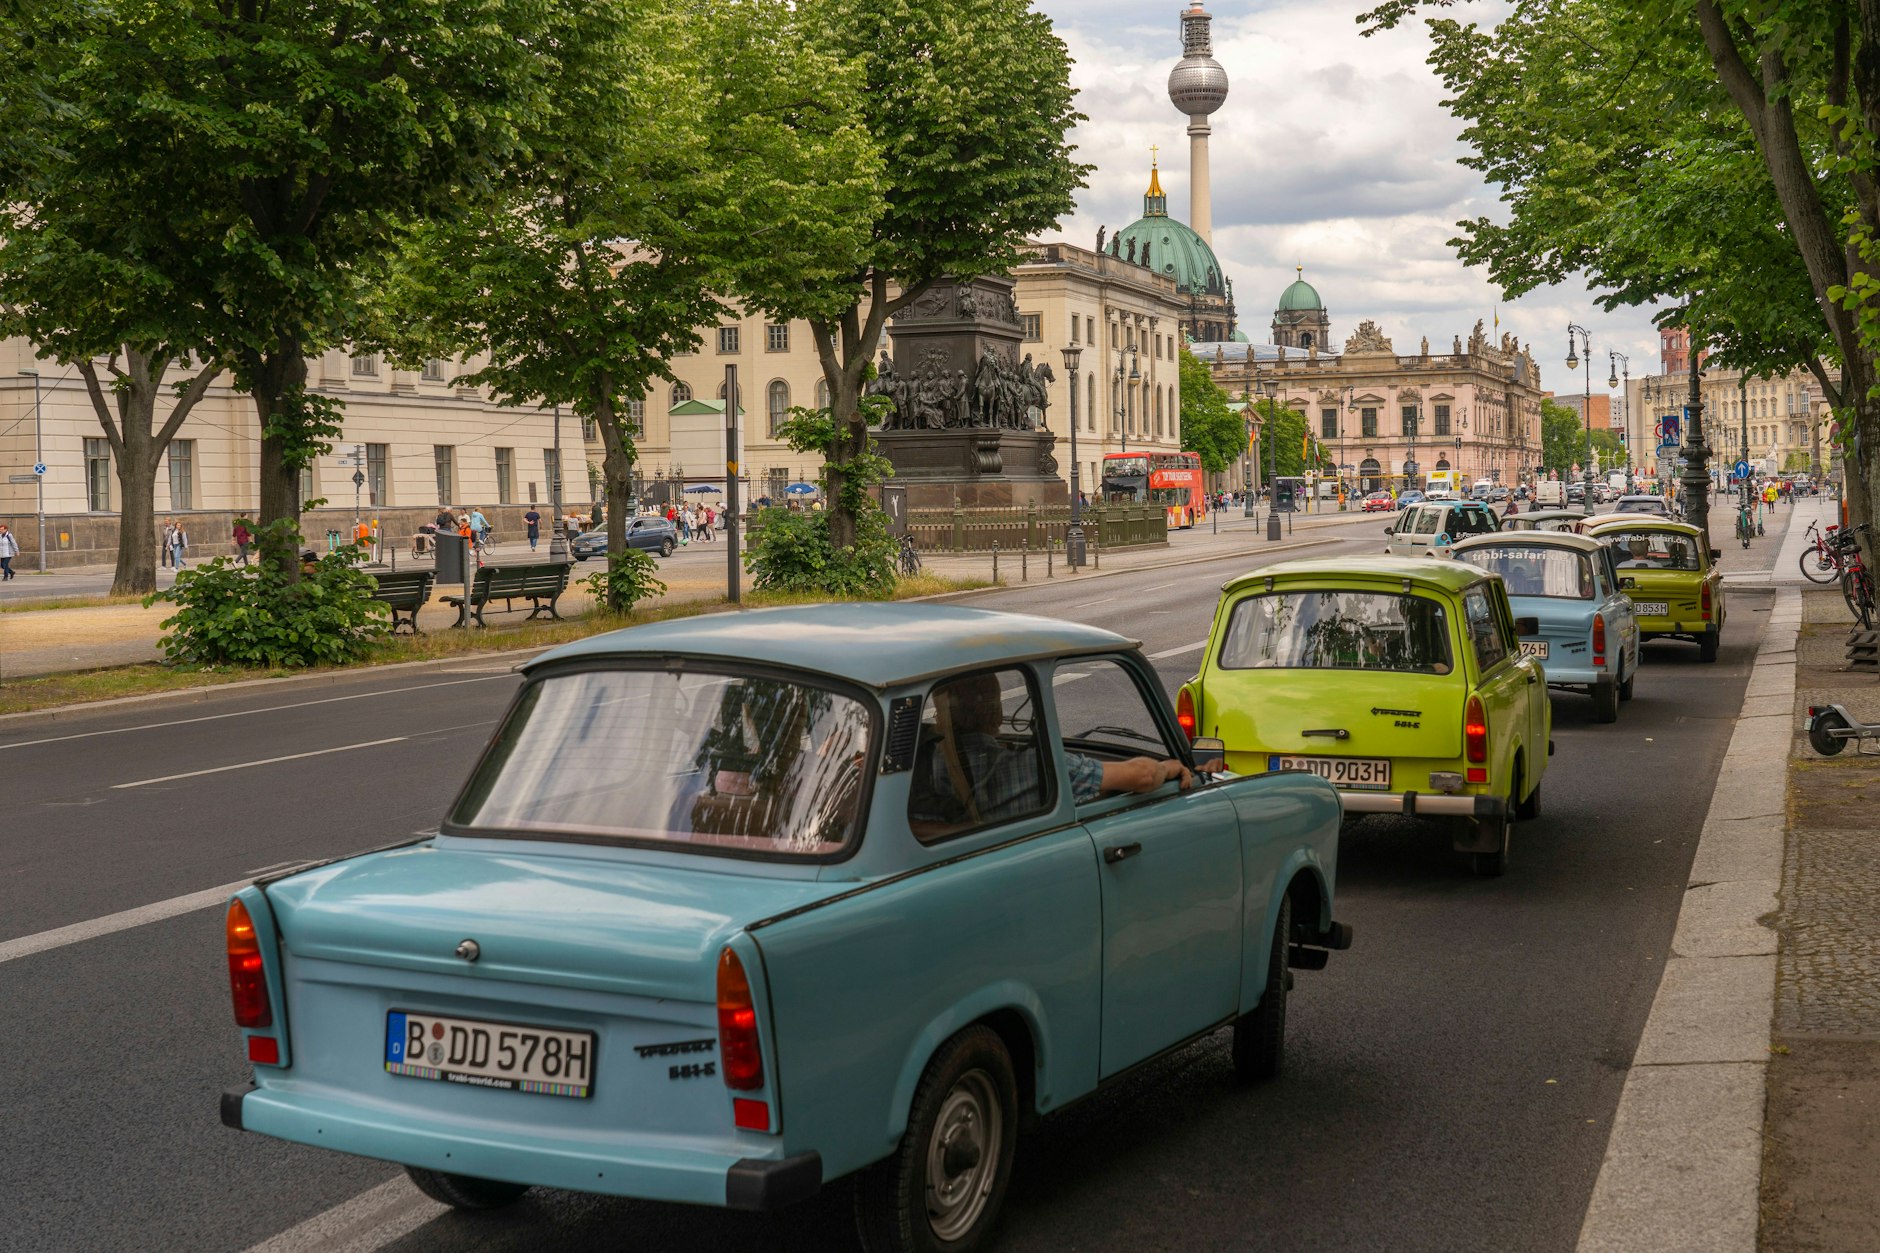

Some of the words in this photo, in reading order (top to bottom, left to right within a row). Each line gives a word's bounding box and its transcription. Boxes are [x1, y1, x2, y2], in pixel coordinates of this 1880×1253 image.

[1335, 762, 1386, 782] 903H
[406, 1021, 425, 1059] B
[448, 1026, 491, 1069] DD
[497, 1031, 587, 1080] 578H
